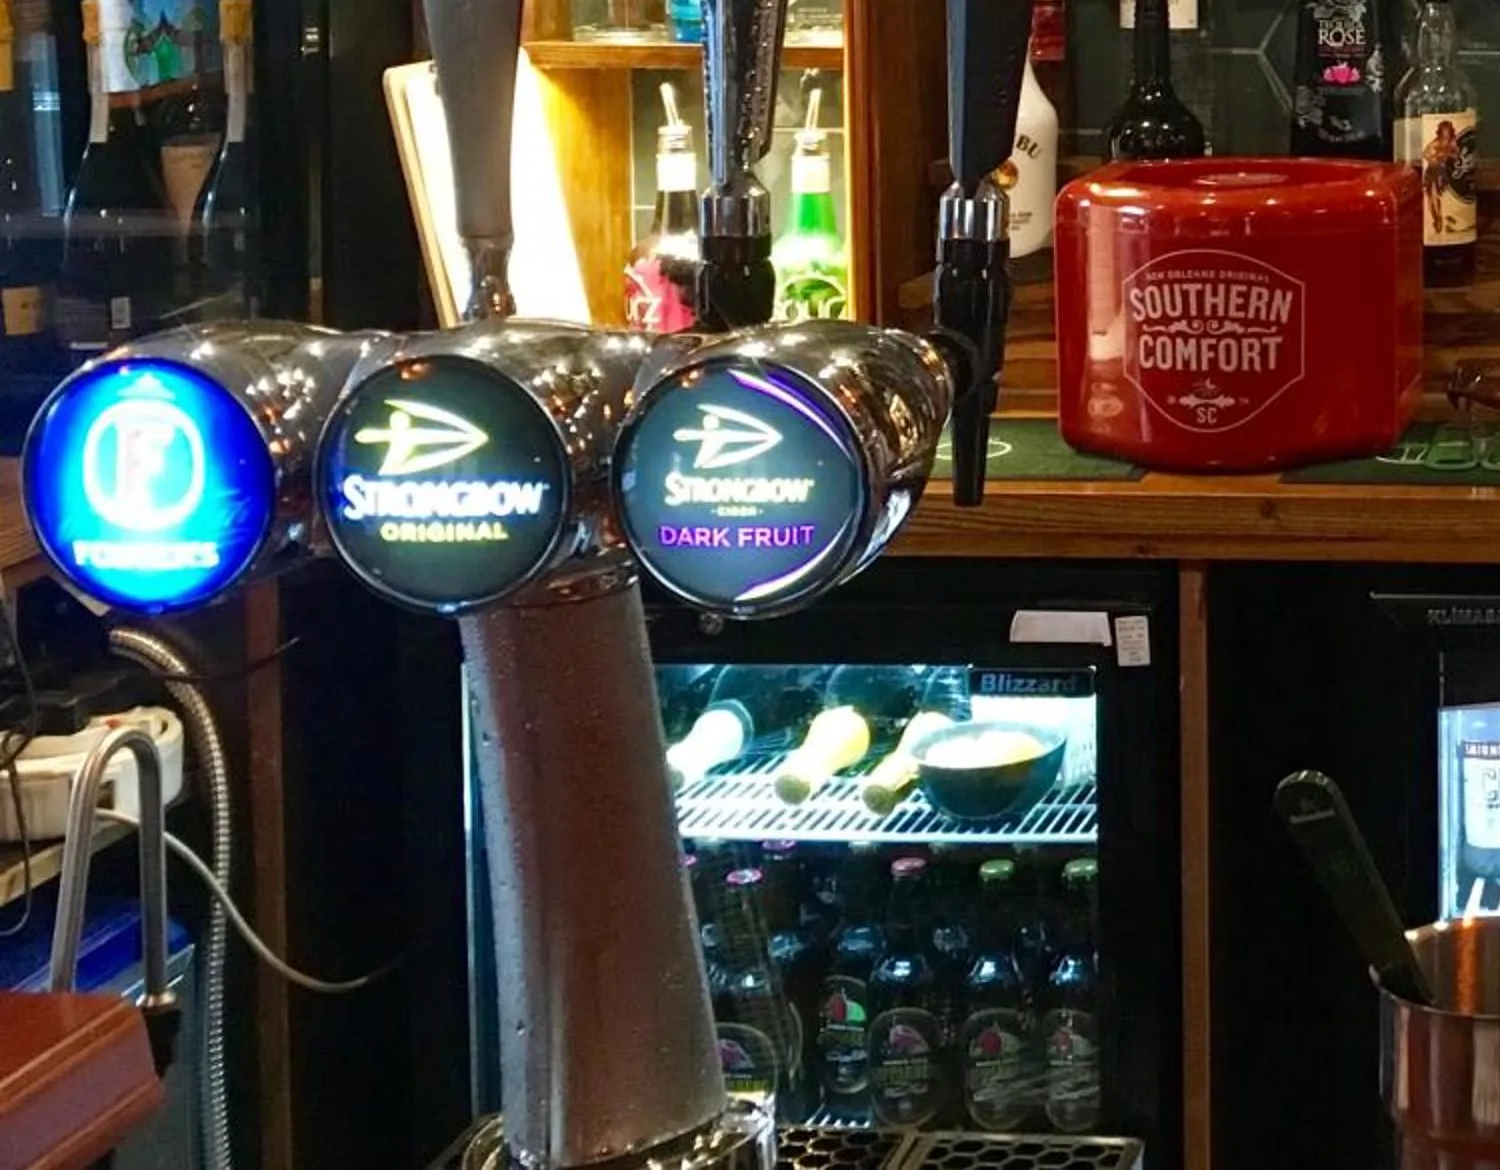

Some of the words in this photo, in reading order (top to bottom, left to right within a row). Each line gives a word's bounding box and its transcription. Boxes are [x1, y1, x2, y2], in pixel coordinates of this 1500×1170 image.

[1318, 29, 1366, 47] ROSE
[1129, 282, 1294, 324] SOUTHERN
[1138, 334, 1284, 374] COMFORT
[1195, 406, 1218, 425] SC
[379, 520, 510, 543] ORIGINAL
[659, 525, 731, 548] DARK
[737, 525, 815, 548] FRUIT
[979, 672, 1079, 694] Blizzard
